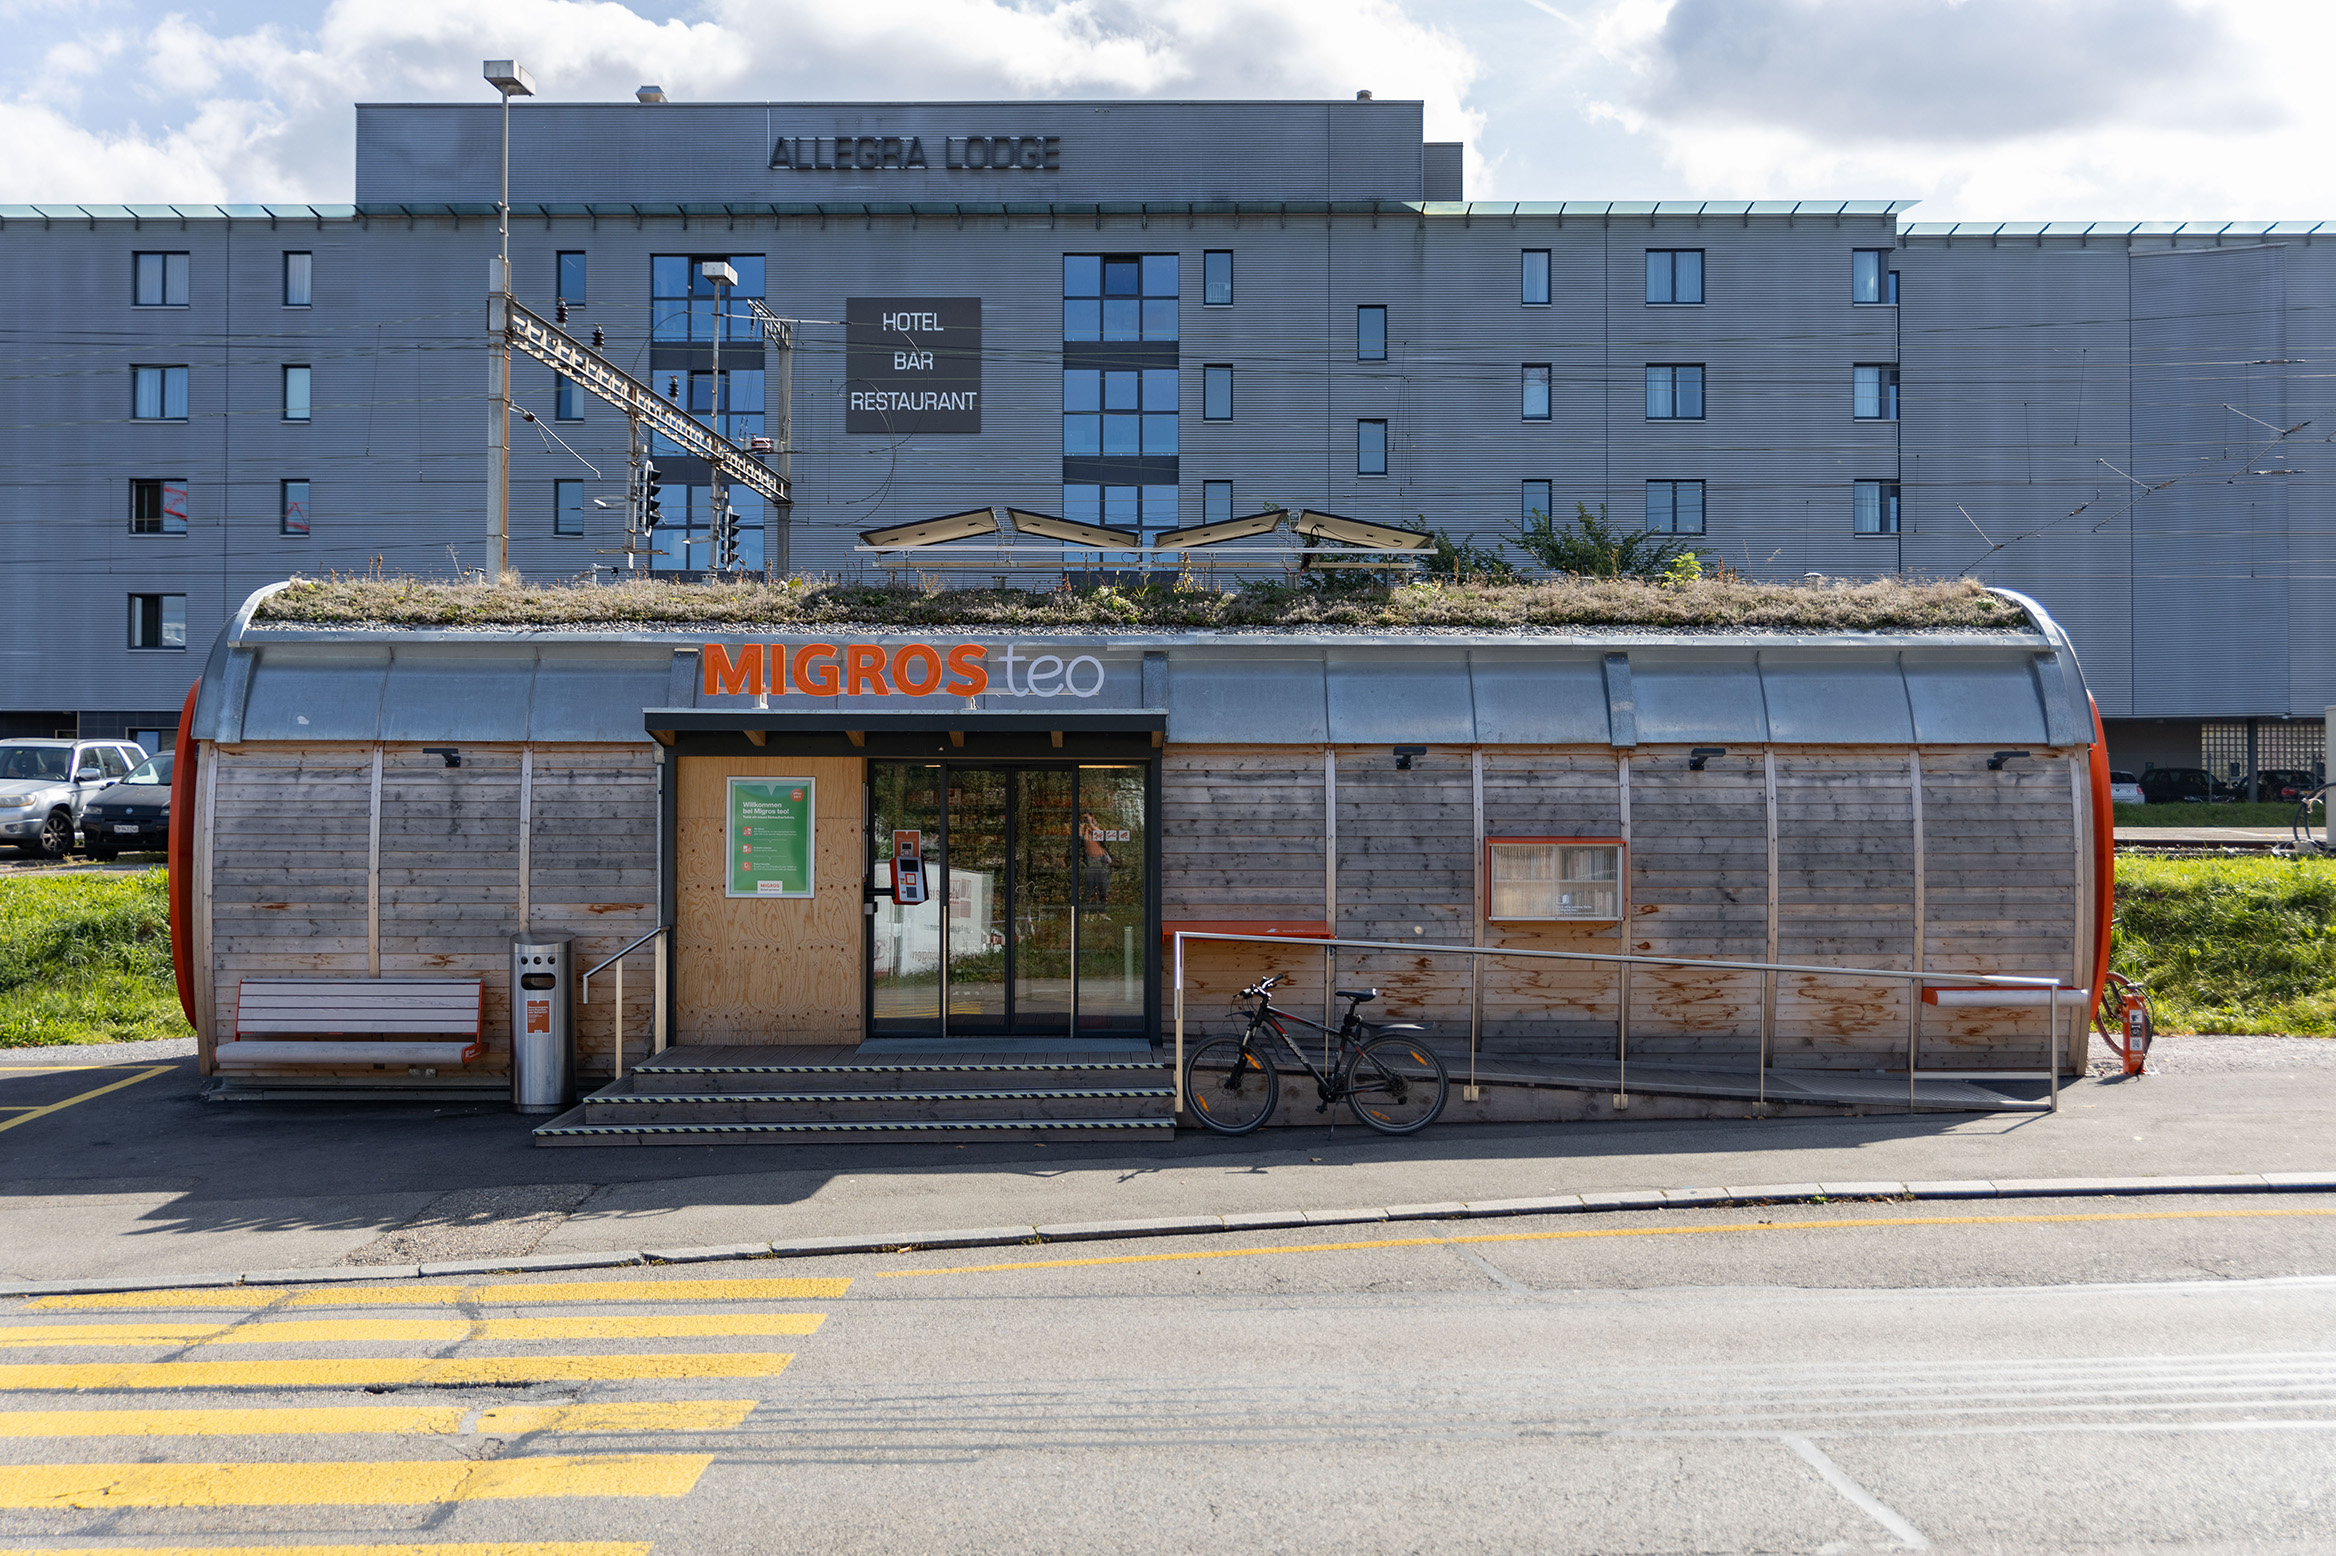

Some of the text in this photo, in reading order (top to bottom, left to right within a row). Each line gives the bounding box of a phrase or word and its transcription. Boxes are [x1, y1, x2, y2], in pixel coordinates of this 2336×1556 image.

[769, 136, 1060, 169] ALLEGRA LODGE
[883, 312, 944, 331] HOTEL
[894, 352, 934, 370] BAR
[850, 392, 977, 411] RESTAURANT
[704, 643, 1105, 698] MIGROS teo
